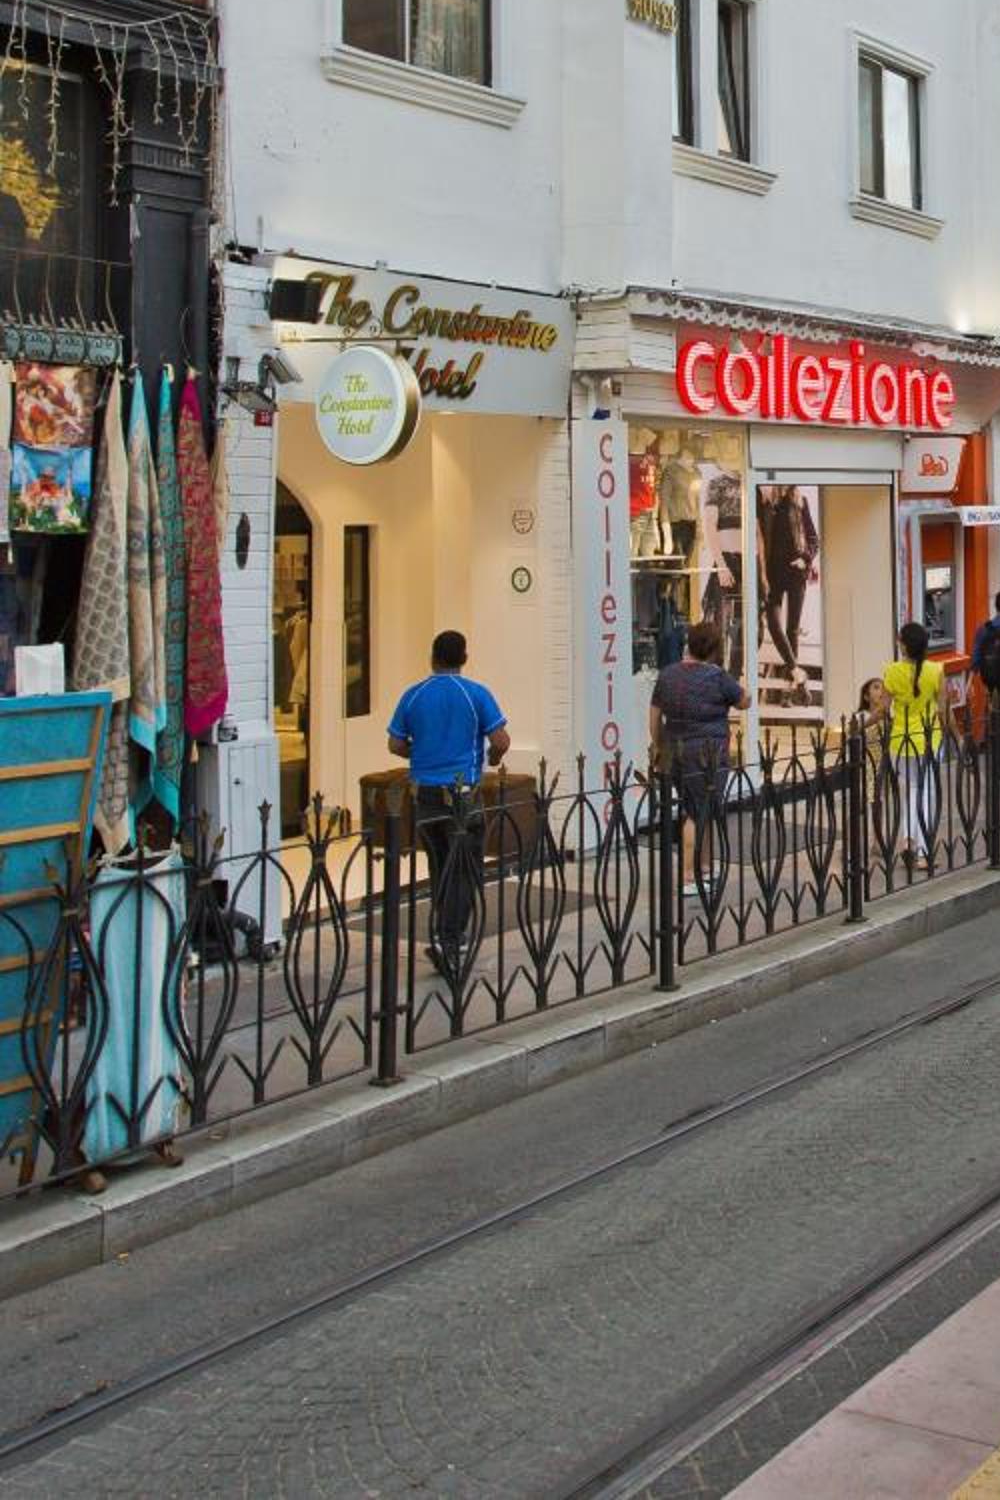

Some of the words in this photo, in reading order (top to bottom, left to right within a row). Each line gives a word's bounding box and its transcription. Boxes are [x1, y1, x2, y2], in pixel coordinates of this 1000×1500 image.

[305, 271, 372, 329] The
[382, 285, 559, 352] Constantine
[343, 374, 369, 394] The
[676, 332, 956, 430] collezione
[319, 395, 393, 414] Constantine
[336, 416, 374, 437] Hotel
